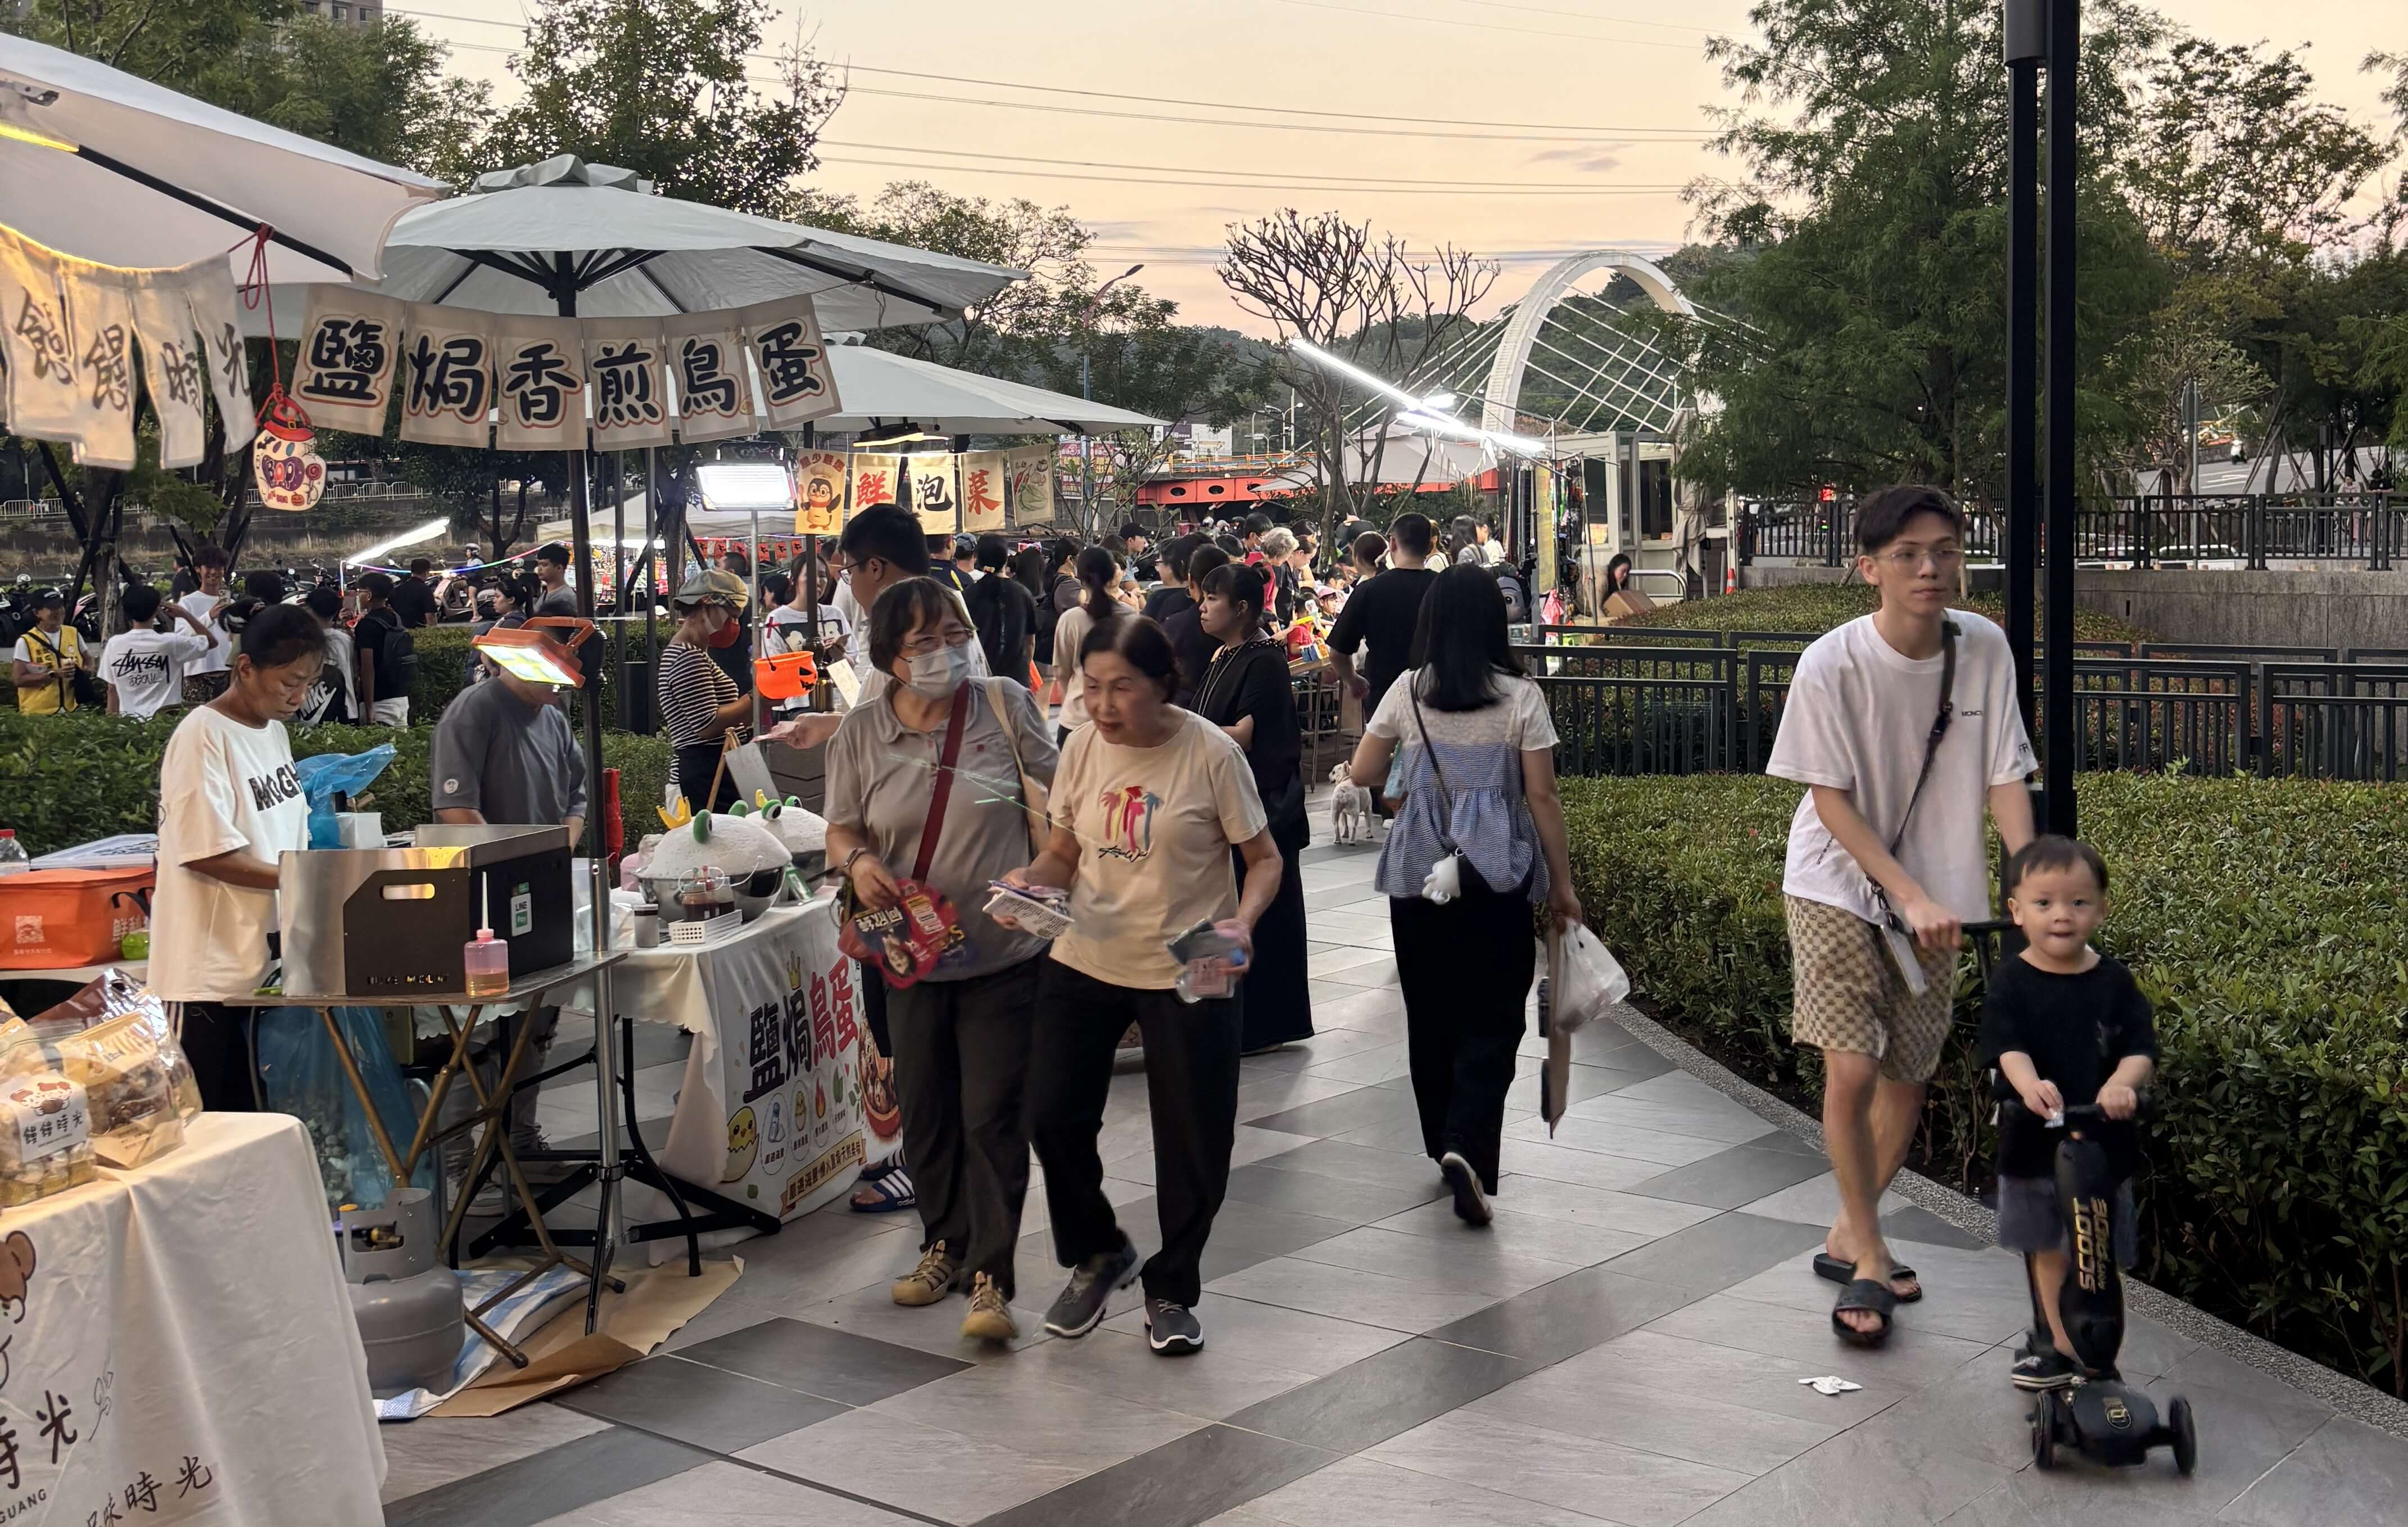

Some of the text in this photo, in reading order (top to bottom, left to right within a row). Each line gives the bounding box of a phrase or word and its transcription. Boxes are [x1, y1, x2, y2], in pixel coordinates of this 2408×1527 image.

[304, 319, 820, 423] 鹽焗香煎鳥蛋
[856, 469, 1002, 515] 鮮泡菜
[515, 901, 527, 911] LINE
[743, 956, 859, 1104] 鹽焗鳥蛋
[2073, 1197, 2096, 1294] SCOOT
